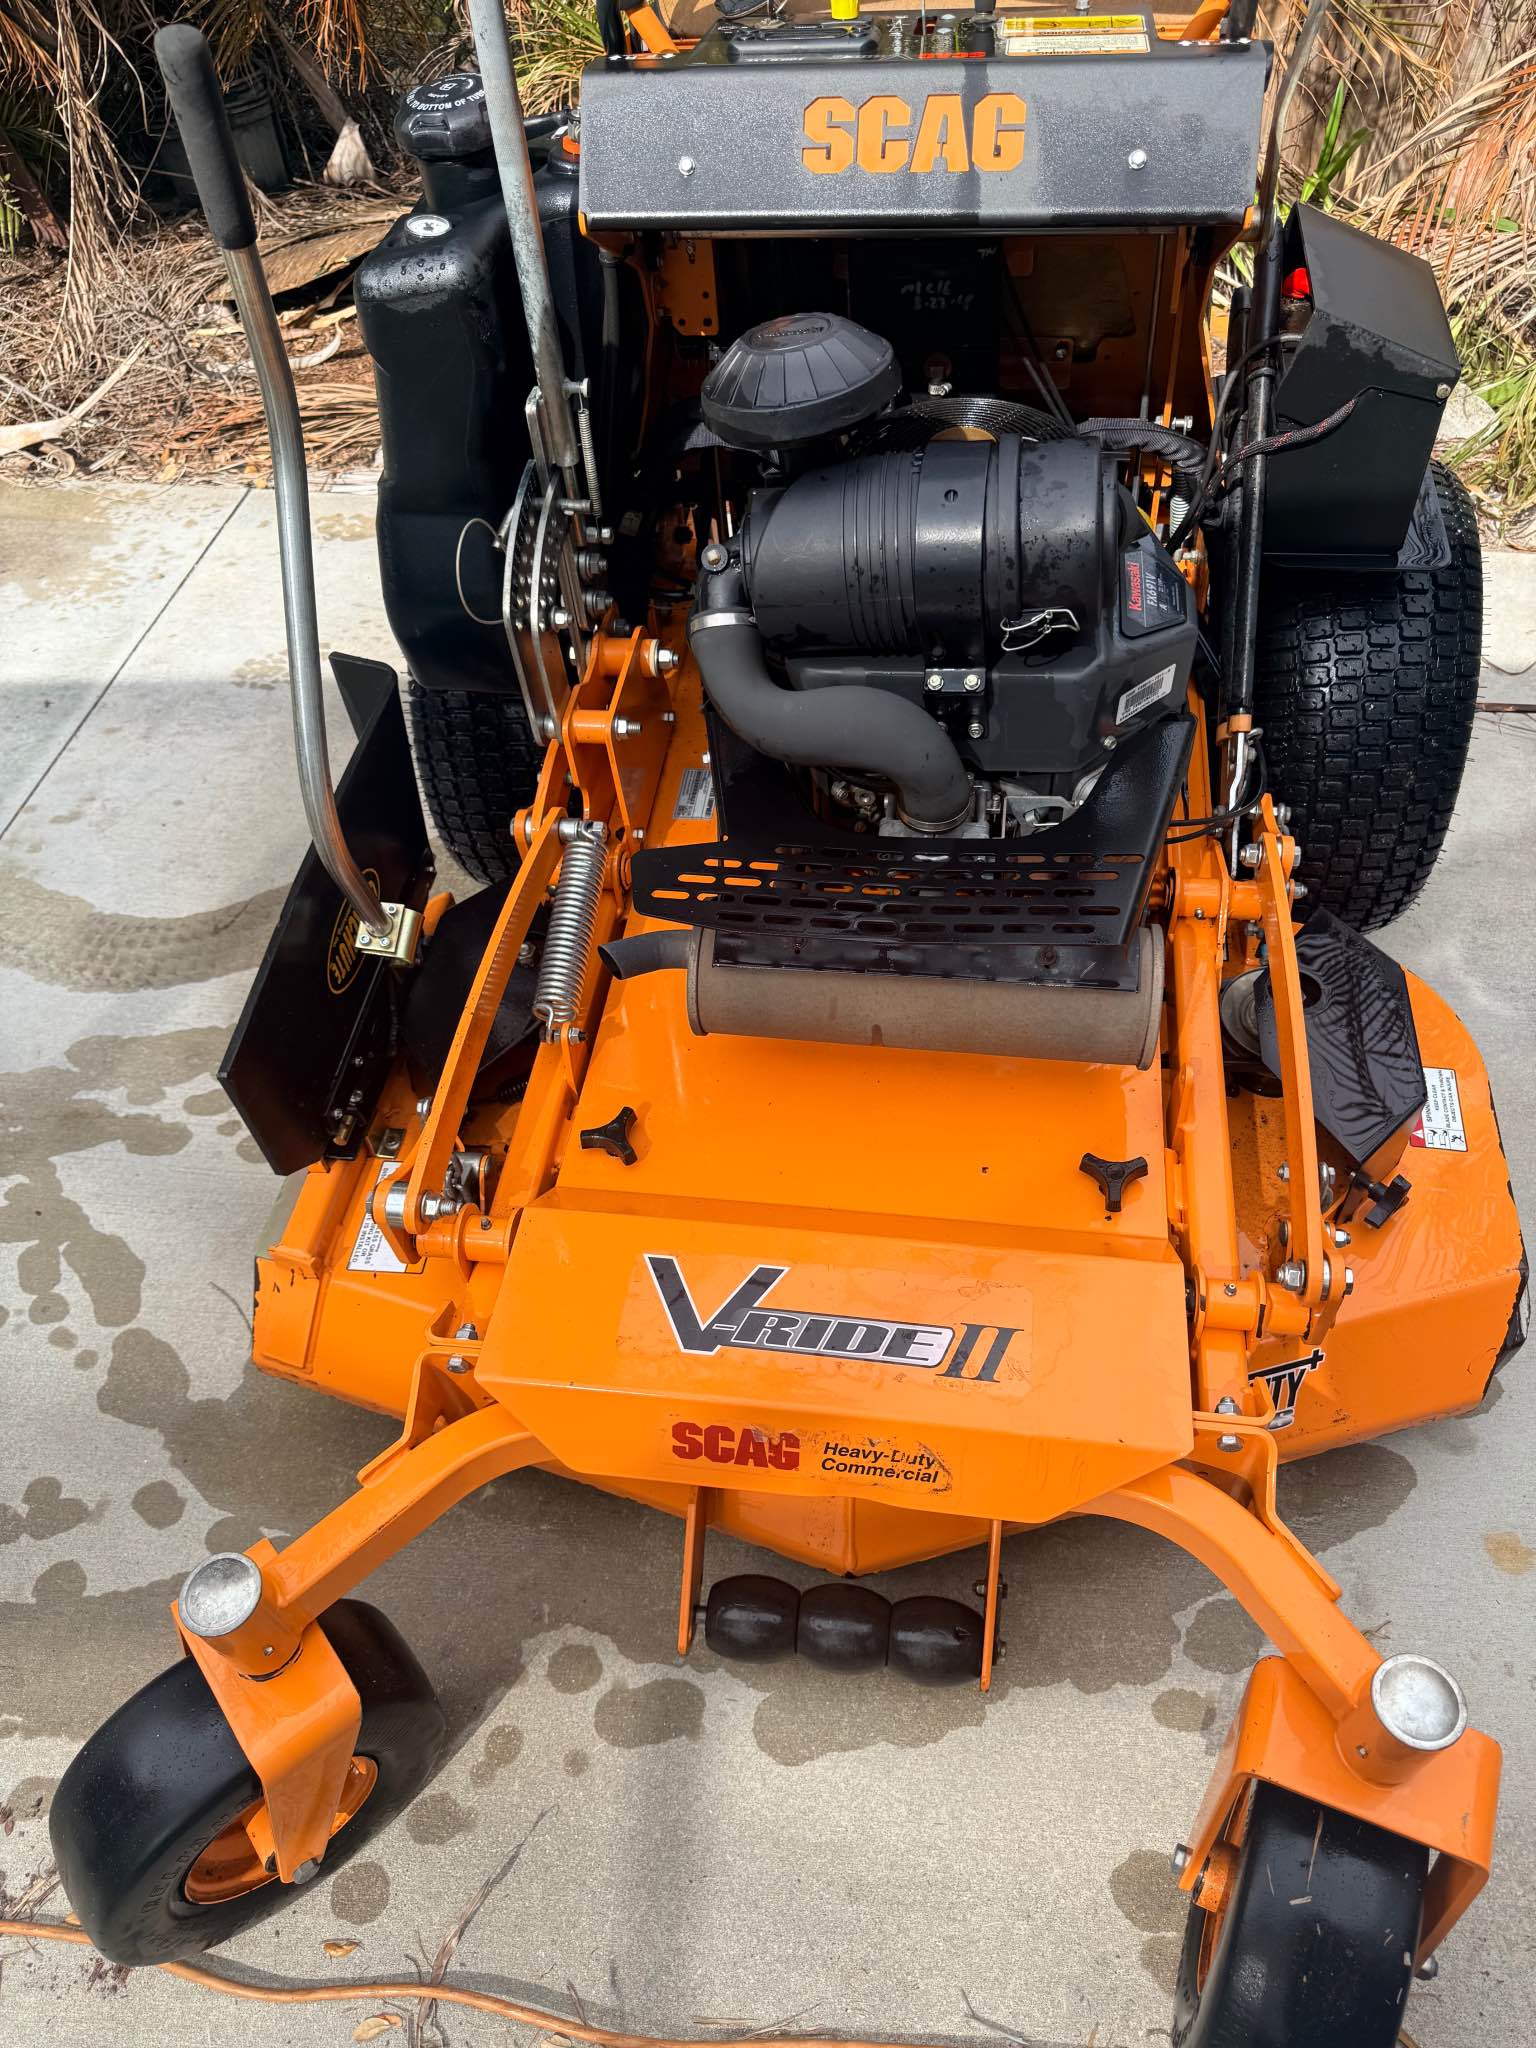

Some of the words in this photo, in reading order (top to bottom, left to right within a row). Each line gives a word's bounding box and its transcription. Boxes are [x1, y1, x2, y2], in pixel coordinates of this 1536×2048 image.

[418, 102, 452, 110] BOTTOM
[454, 98, 467, 107] OF
[466, 89, 486, 102] TUB
[802, 92, 1027, 174] SCAG
[1128, 561, 1143, 612] Kawasaki
[1145, 572, 1158, 607] FX691V
[352, 1230, 367, 1263] INSTALLED
[364, 1244, 376, 1264] GRASS
[672, 1421, 800, 1472] SCAG
[824, 1442, 935, 1470] Heavy-Duty
[821, 1457, 938, 1483] Commercial
